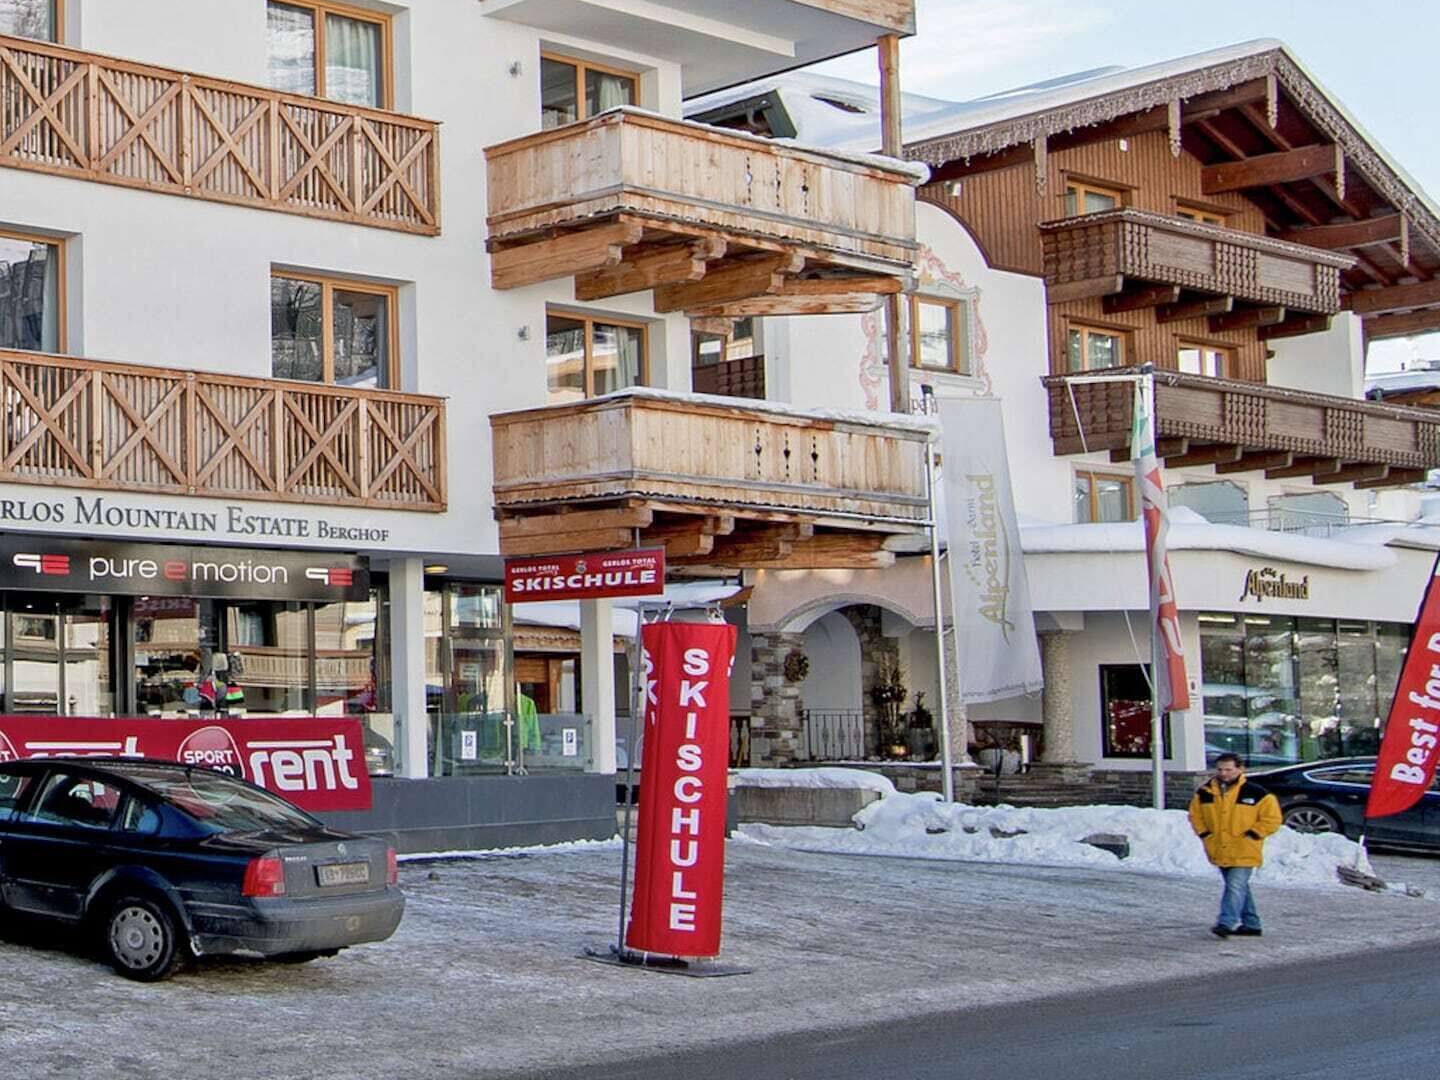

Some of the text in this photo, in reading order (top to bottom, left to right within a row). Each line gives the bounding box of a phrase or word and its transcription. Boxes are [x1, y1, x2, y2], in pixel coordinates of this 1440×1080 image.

[74, 496, 217, 531] MOUNTAIN
[226, 506, 310, 538] ESTATE
[318, 520, 390, 542] BERGHOF
[90, 557, 158, 581] pure
[192, 560, 288, 584] motion
[602, 560, 630, 568] GERLOS
[632, 557, 656, 565] TOTAL
[966, 475, 1014, 636] Alpenland
[512, 570, 656, 592] SKISCHULE
[1240, 569, 1309, 602] Alpenland
[184, 750, 233, 764] SPORT
[250, 734, 359, 791] rent
[1390, 717, 1439, 785] Best
[669, 648, 710, 932] SKISCHULE
